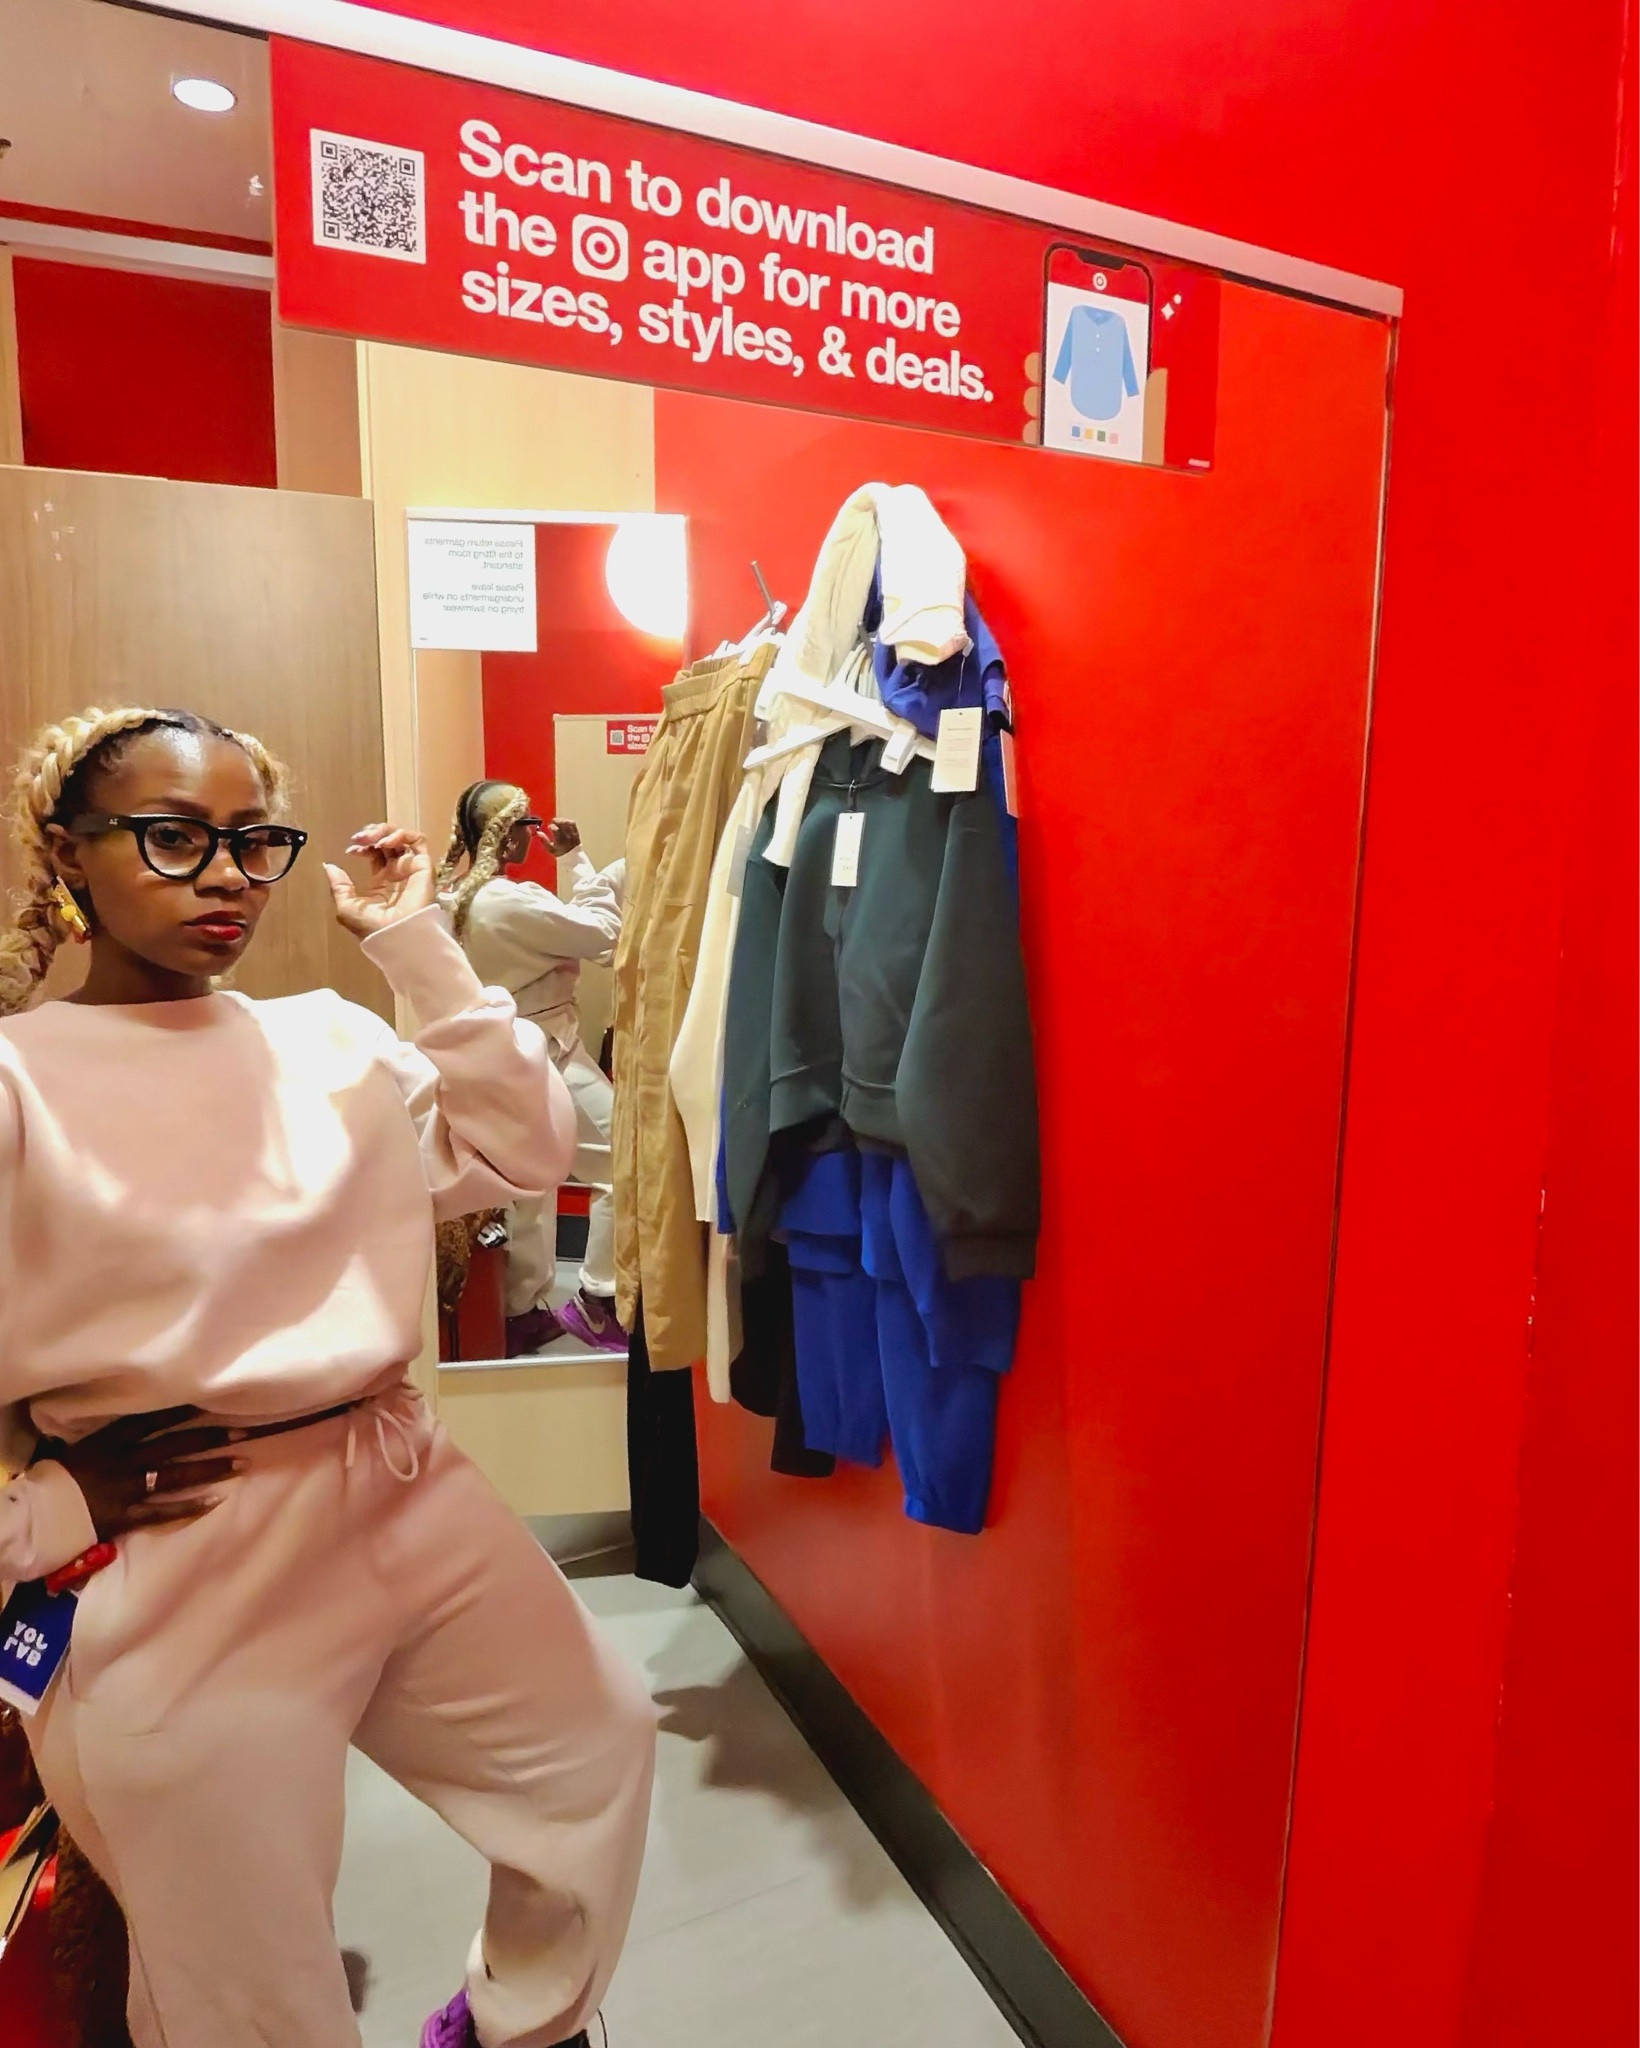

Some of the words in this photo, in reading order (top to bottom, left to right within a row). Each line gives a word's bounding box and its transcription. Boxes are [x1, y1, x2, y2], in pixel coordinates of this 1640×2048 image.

[458, 119, 612, 204] Scan
[624, 159, 683, 217] to
[696, 177, 935, 275] download
[458, 190, 558, 257] the
[642, 239, 746, 304] app
[758, 252, 831, 311] for
[841, 280, 962, 338] more
[461, 260, 623, 346] sizes,
[638, 298, 805, 377] styles,
[817, 325, 855, 378] &
[865, 336, 994, 403] deals.
[627, 724, 648, 733] Scan
